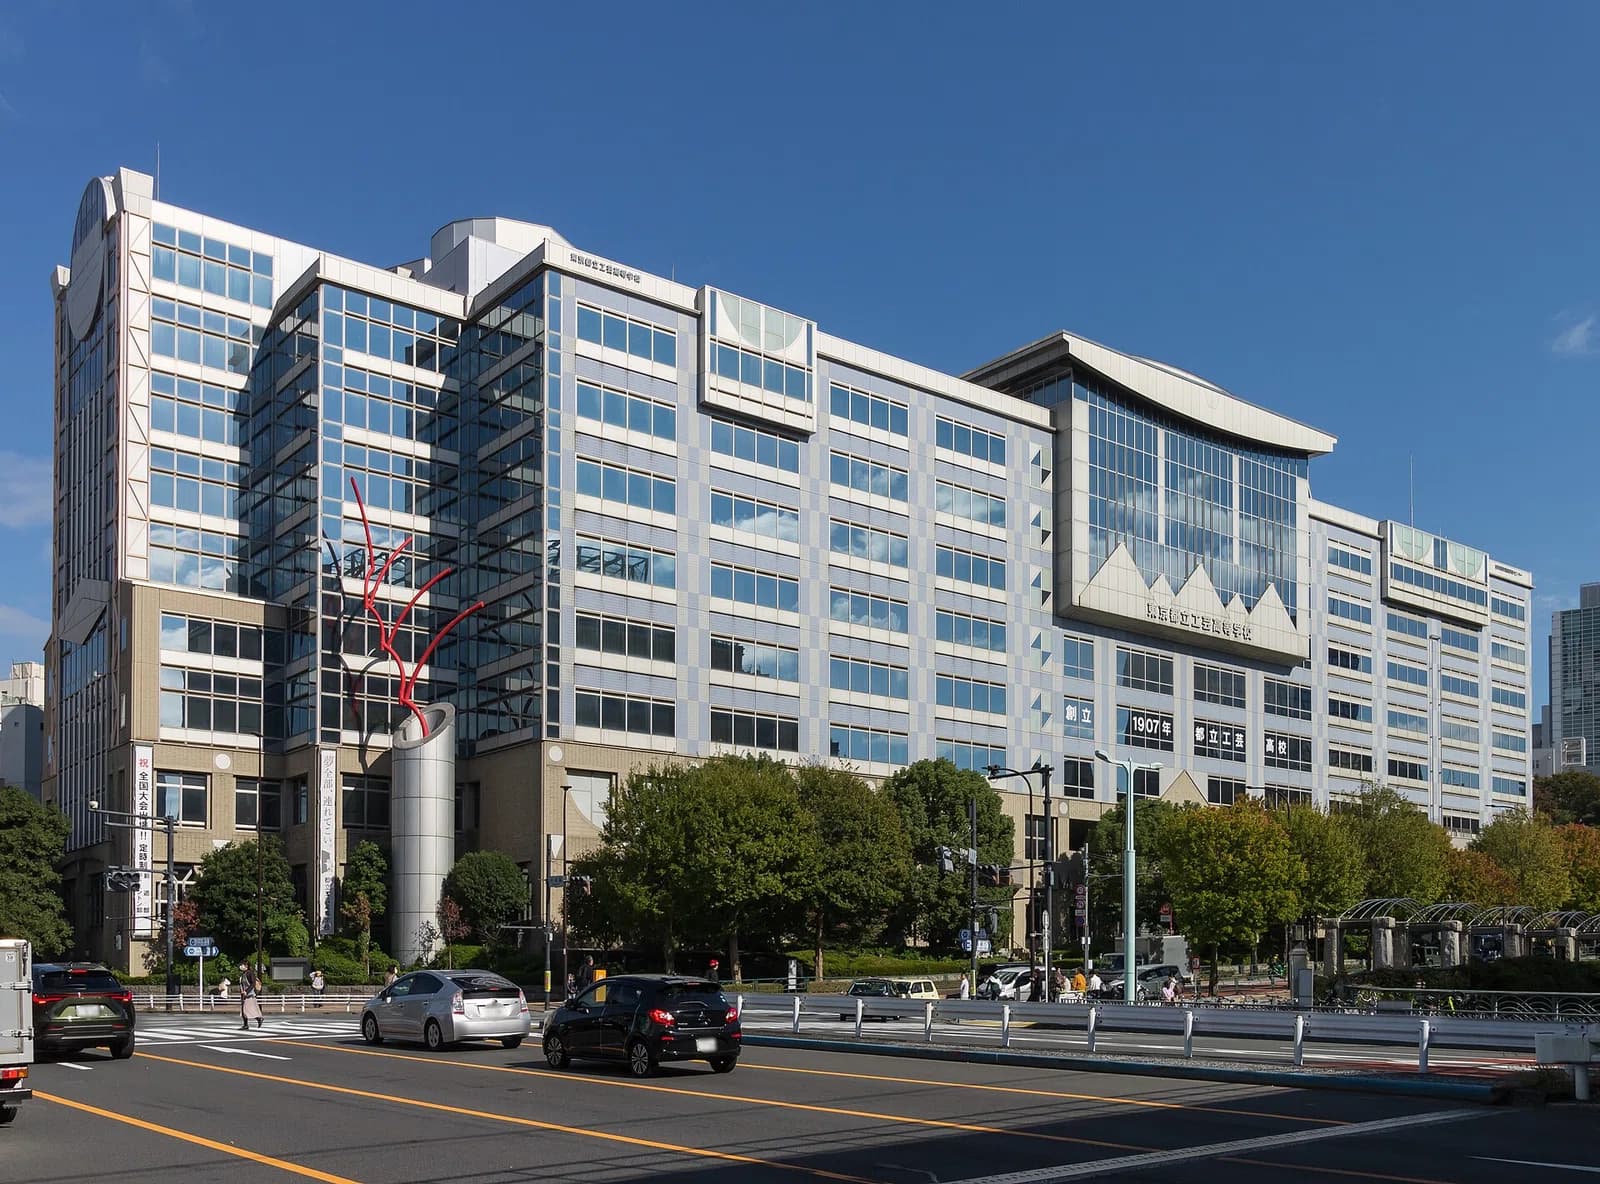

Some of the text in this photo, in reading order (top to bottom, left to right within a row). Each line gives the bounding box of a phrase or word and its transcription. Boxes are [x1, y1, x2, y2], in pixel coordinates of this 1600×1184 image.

[1146, 602, 1252, 641] 東京都立工芸高等学校
[1065, 704, 1287, 756] 創立 1907年 都立工芸 高校
